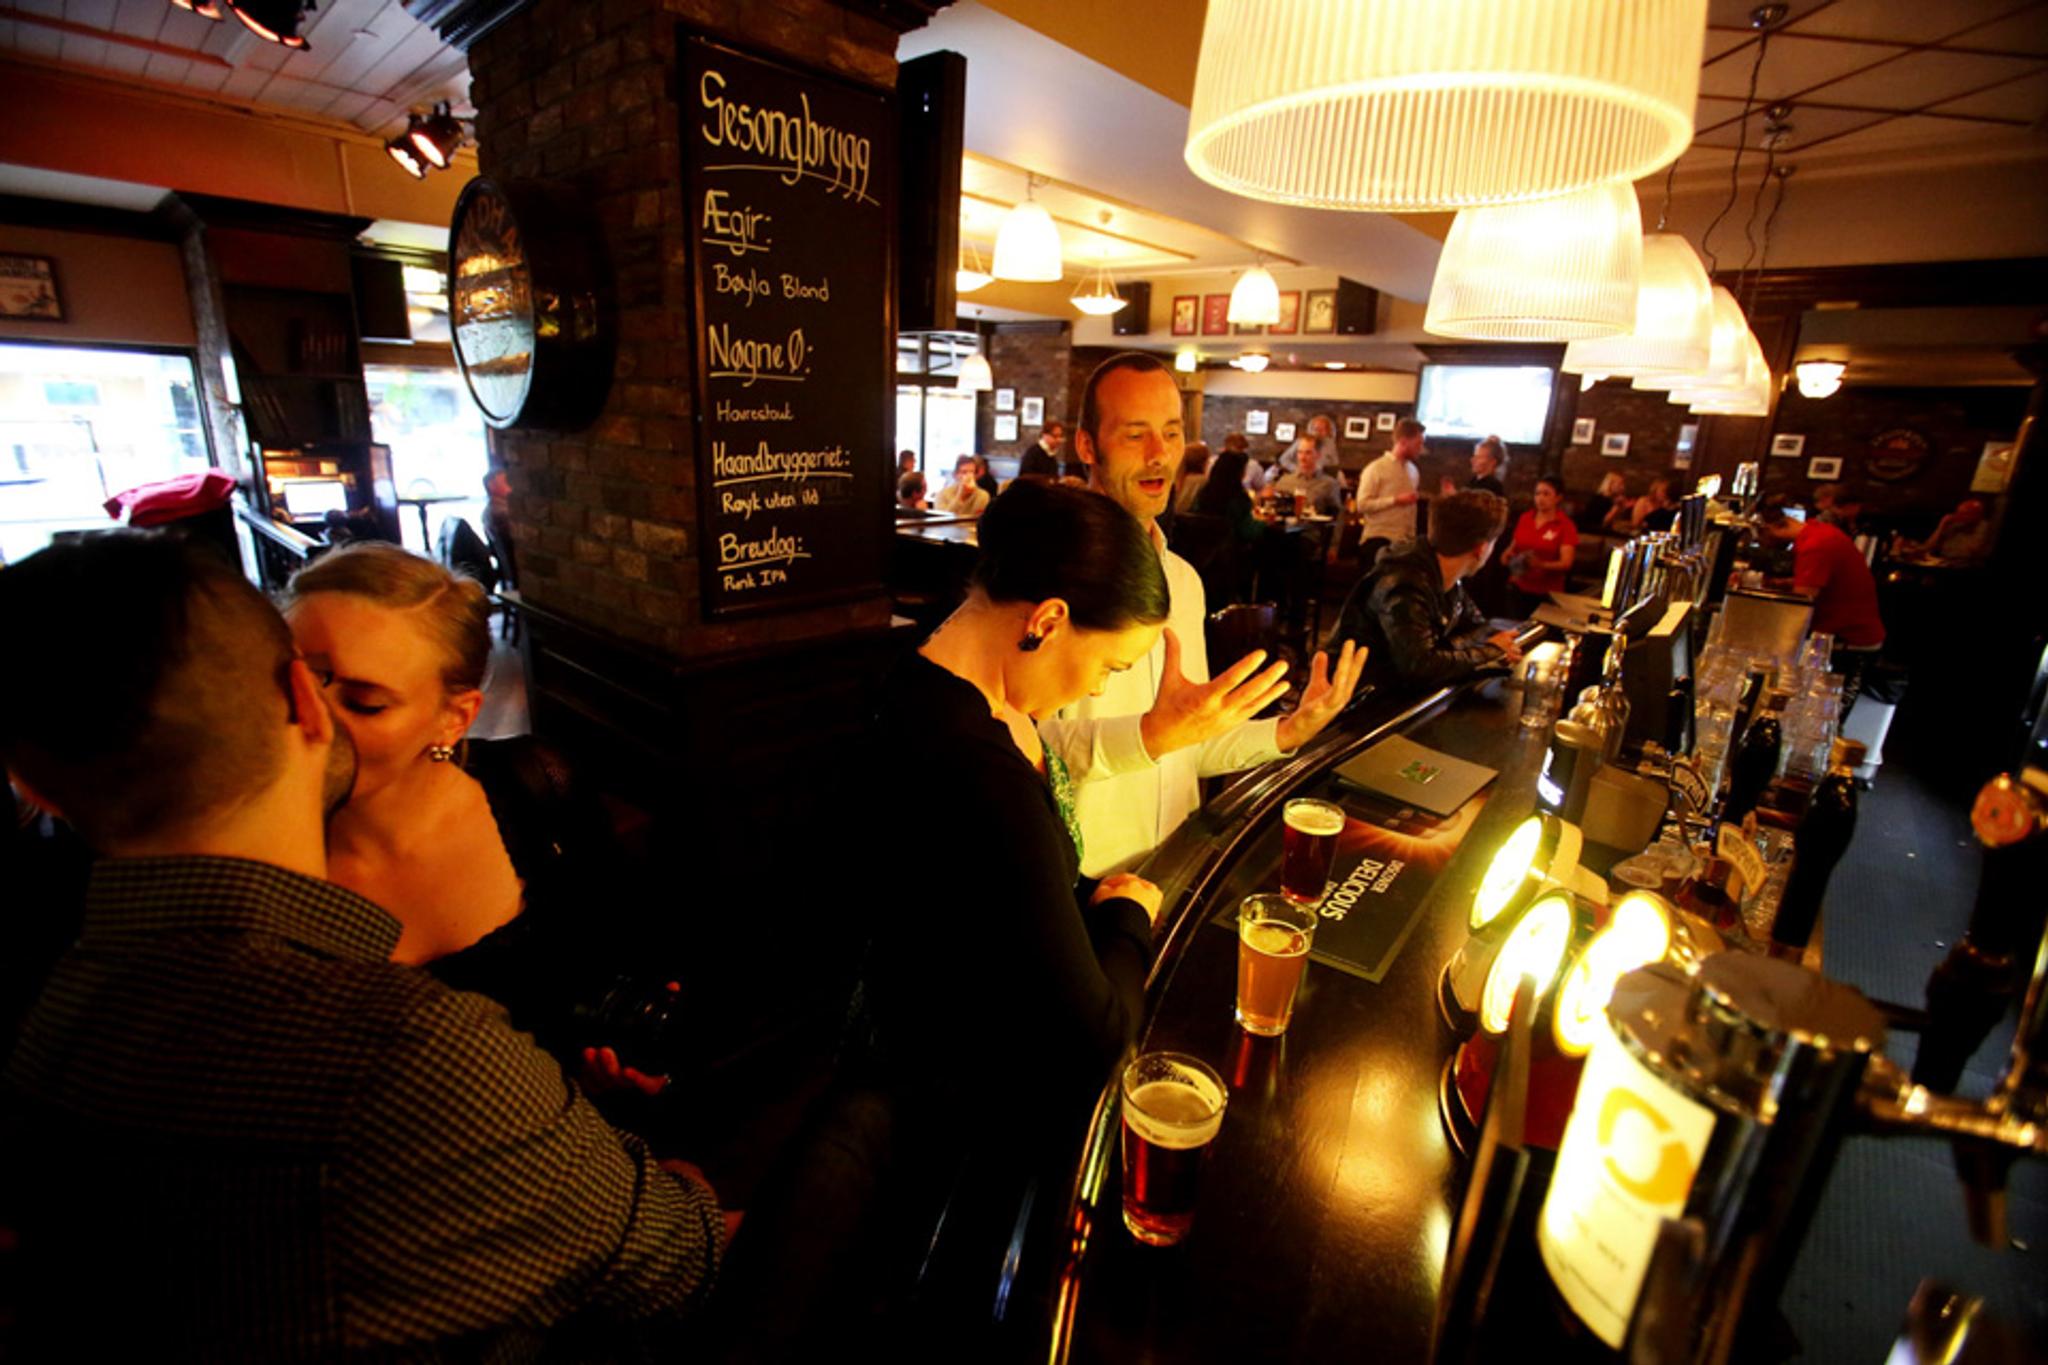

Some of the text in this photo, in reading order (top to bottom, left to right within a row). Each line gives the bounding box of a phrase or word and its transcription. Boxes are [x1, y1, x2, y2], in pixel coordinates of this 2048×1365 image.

[700, 70, 870, 202] Sesongbrygg
[702, 189, 772, 256] Ægir:
[708, 323, 784, 387] Nøgne
[712, 440, 851, 482] Haandbryggeriet:
[722, 492, 762, 520] Røyk
[718, 526, 804, 566] Brewdog:
[1319, 857, 1385, 921] DELICIOUS
